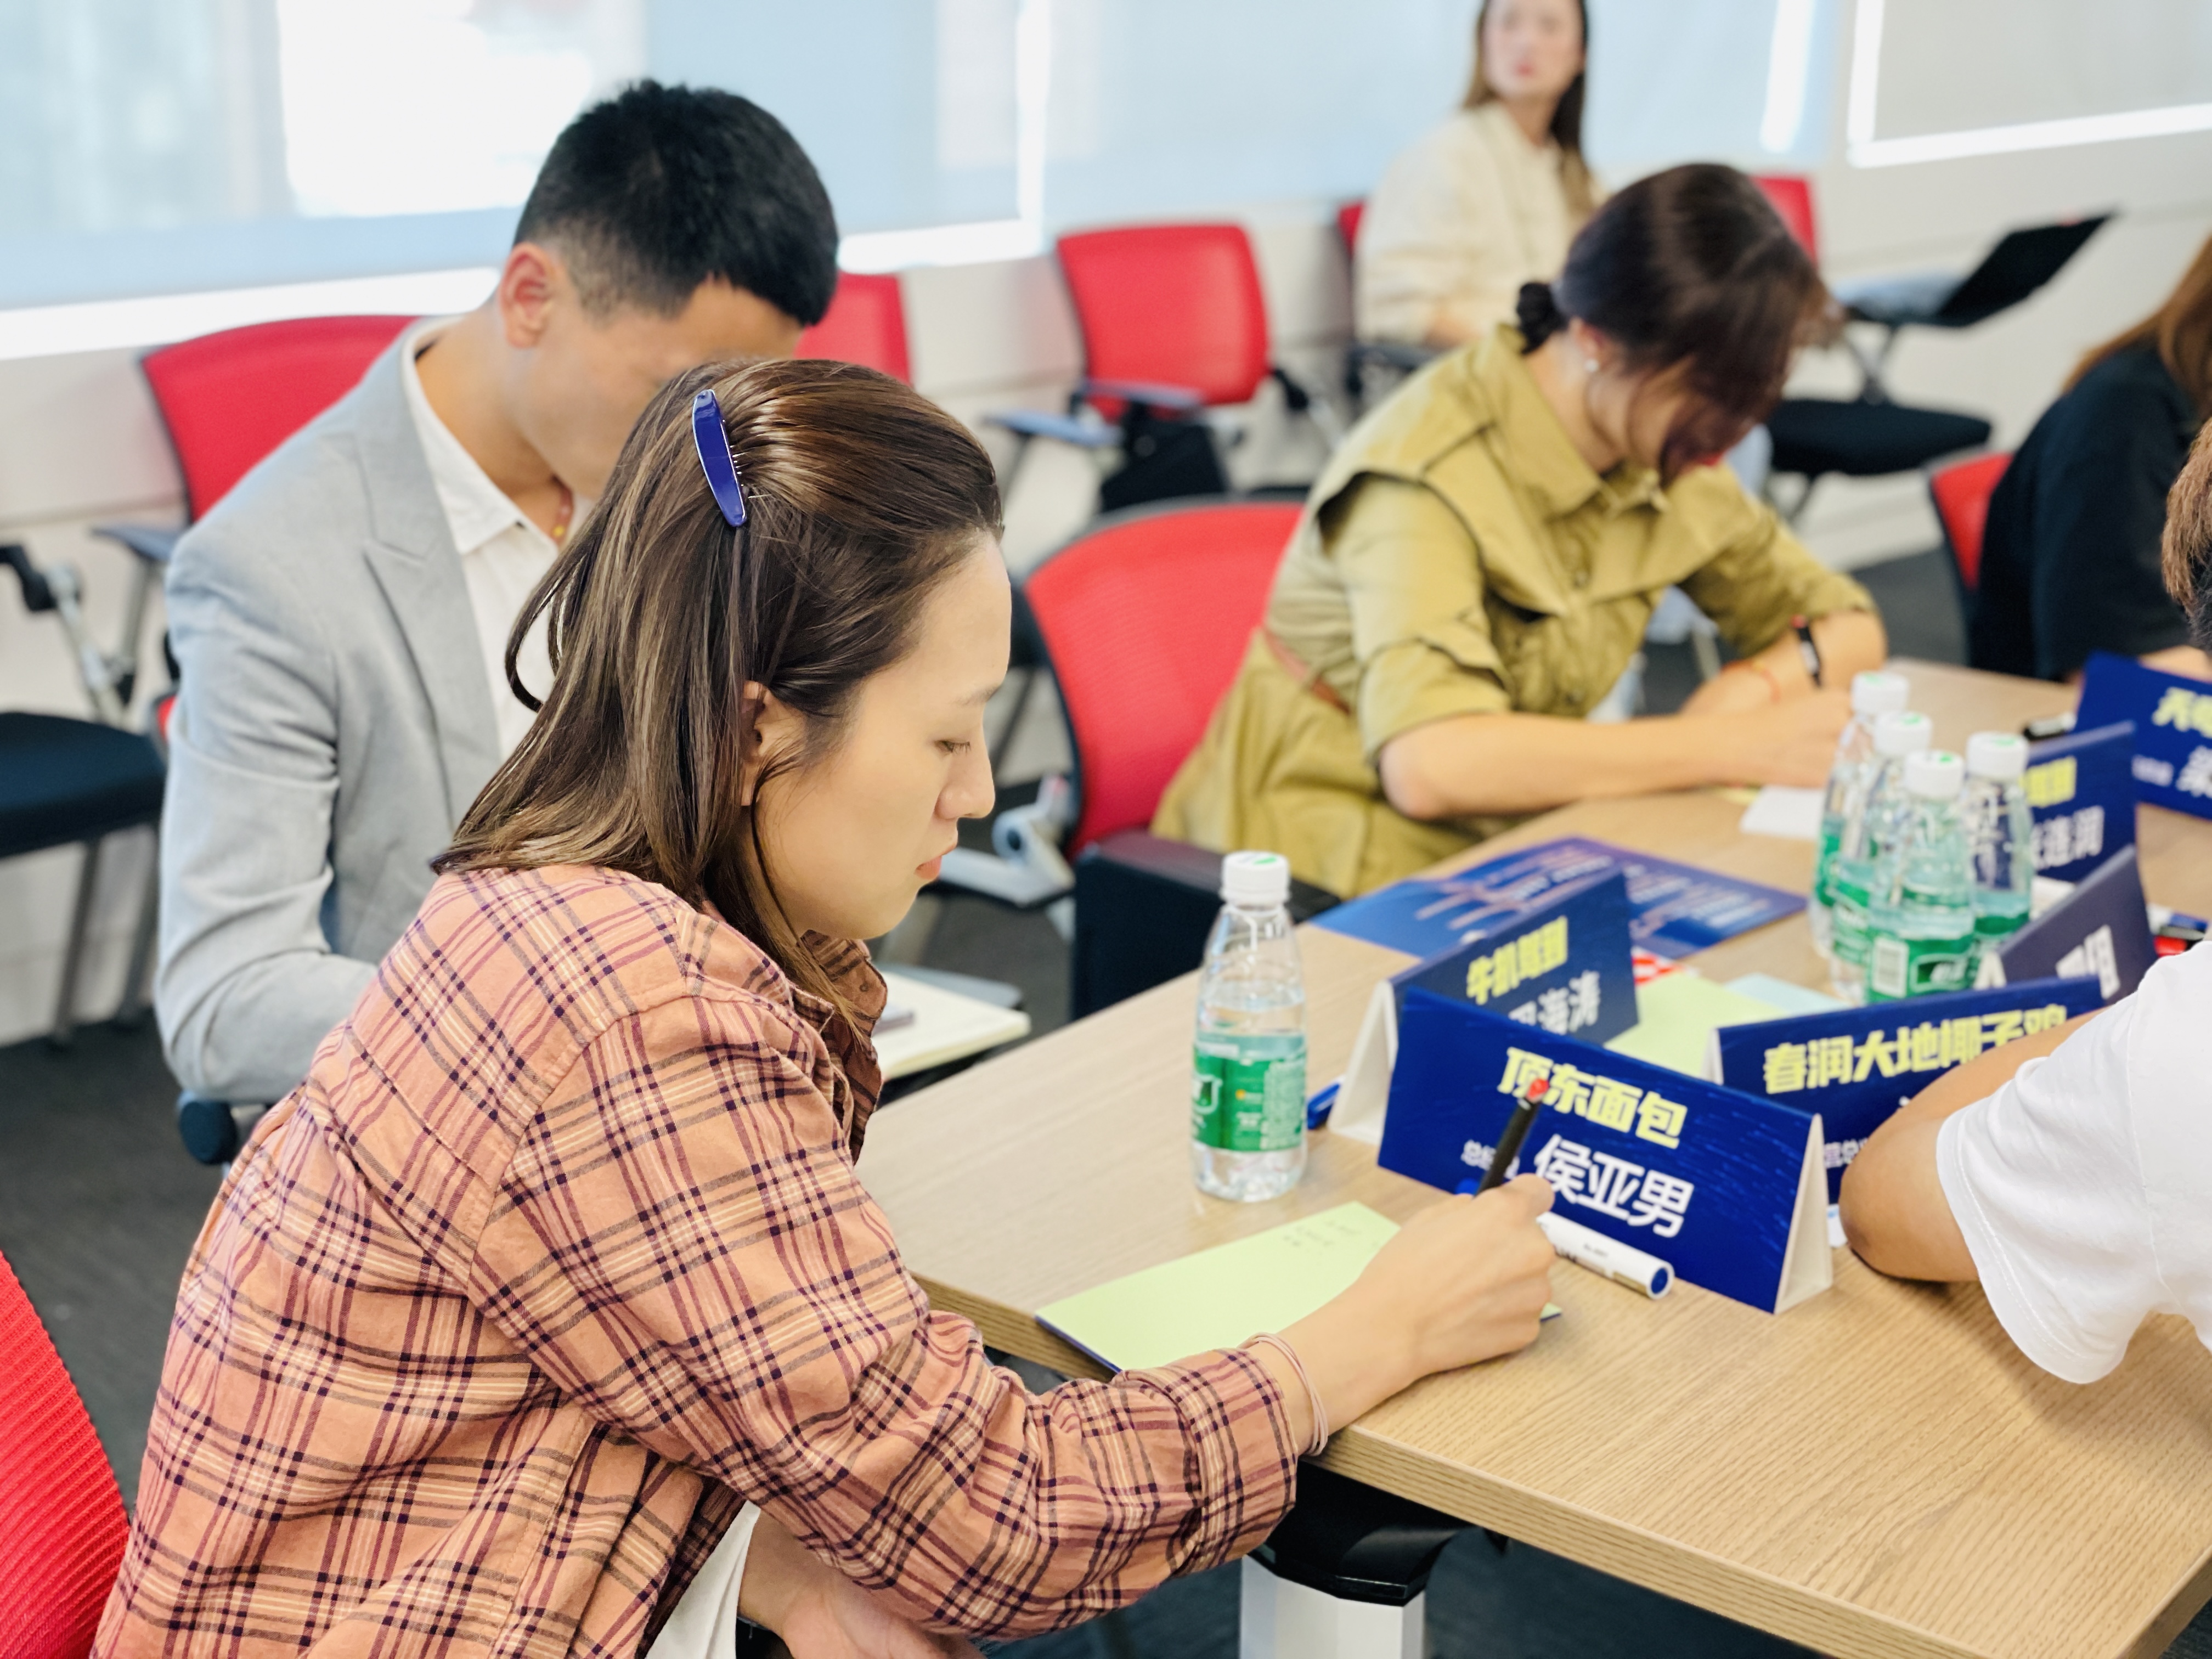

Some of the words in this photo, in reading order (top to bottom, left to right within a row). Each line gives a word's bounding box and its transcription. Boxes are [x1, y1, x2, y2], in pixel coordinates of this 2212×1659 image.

[1497, 1046, 1689, 1149] 顶东面包
[1534, 1133, 1695, 1238] 侯亚男
